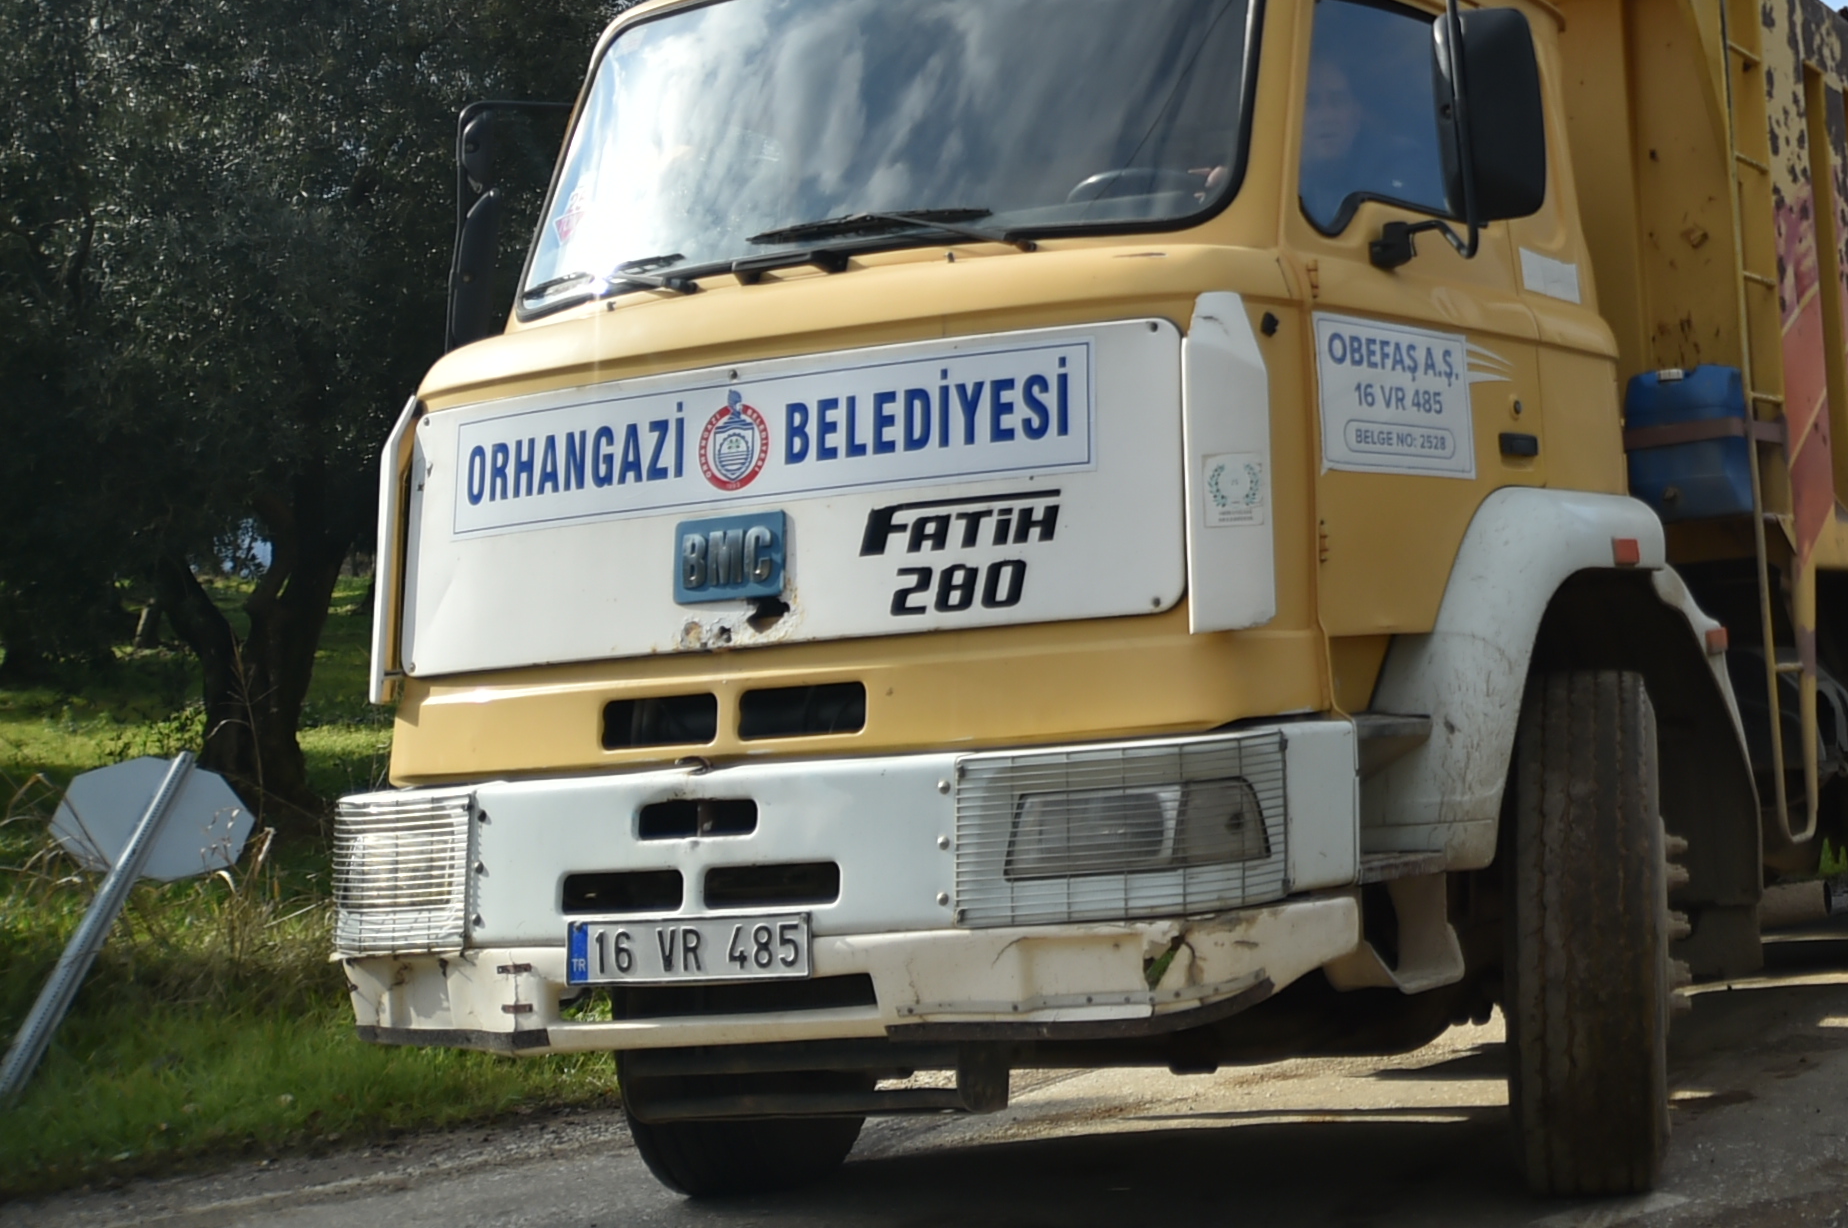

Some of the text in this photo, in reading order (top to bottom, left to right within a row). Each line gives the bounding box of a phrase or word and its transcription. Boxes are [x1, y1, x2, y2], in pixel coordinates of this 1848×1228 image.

[1328, 332, 1460, 388] OBEFAŞ A.Ş.
[1353, 382, 1443, 415] 16 VR 485
[467, 356, 1069, 506] ORHANGAZİ BELEDİYESİ
[1355, 428, 1447, 451] BELGE NO: 2528
[682, 526, 773, 590] BMC
[890, 559, 1027, 616] 280
[571, 959, 587, 972] TR
[594, 921, 800, 975] 16 VR 485
